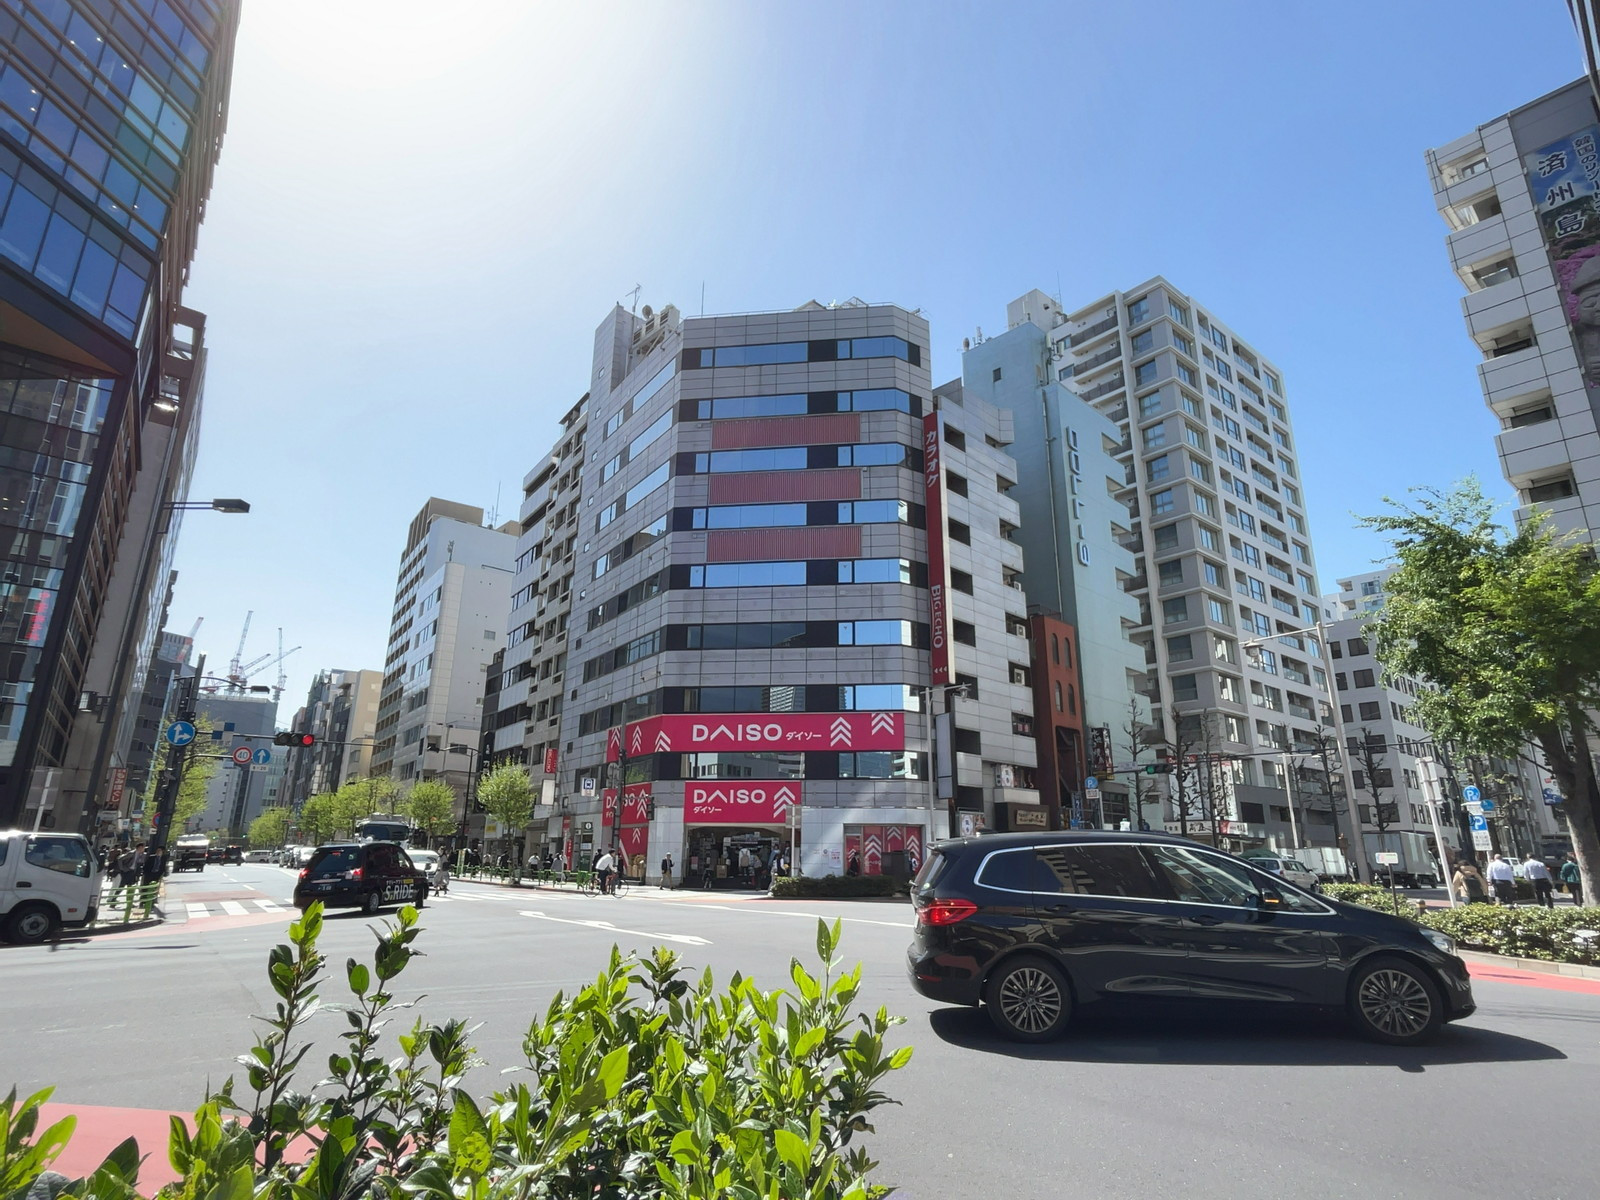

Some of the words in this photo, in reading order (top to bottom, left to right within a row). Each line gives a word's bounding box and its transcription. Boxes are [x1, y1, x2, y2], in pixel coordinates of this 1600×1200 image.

[1538, 151, 1585, 237] 済州島
[926, 430, 939, 488] カラオケ
[931, 584, 942, 610] BIG
[933, 612, 944, 649] ECHO
[692, 723, 782, 742] DAISO
[786, 731, 822, 741] ダイソー
[238, 751, 248, 759] 40
[693, 788, 766, 804] DAISO
[693, 806, 722, 814] ダイソー
